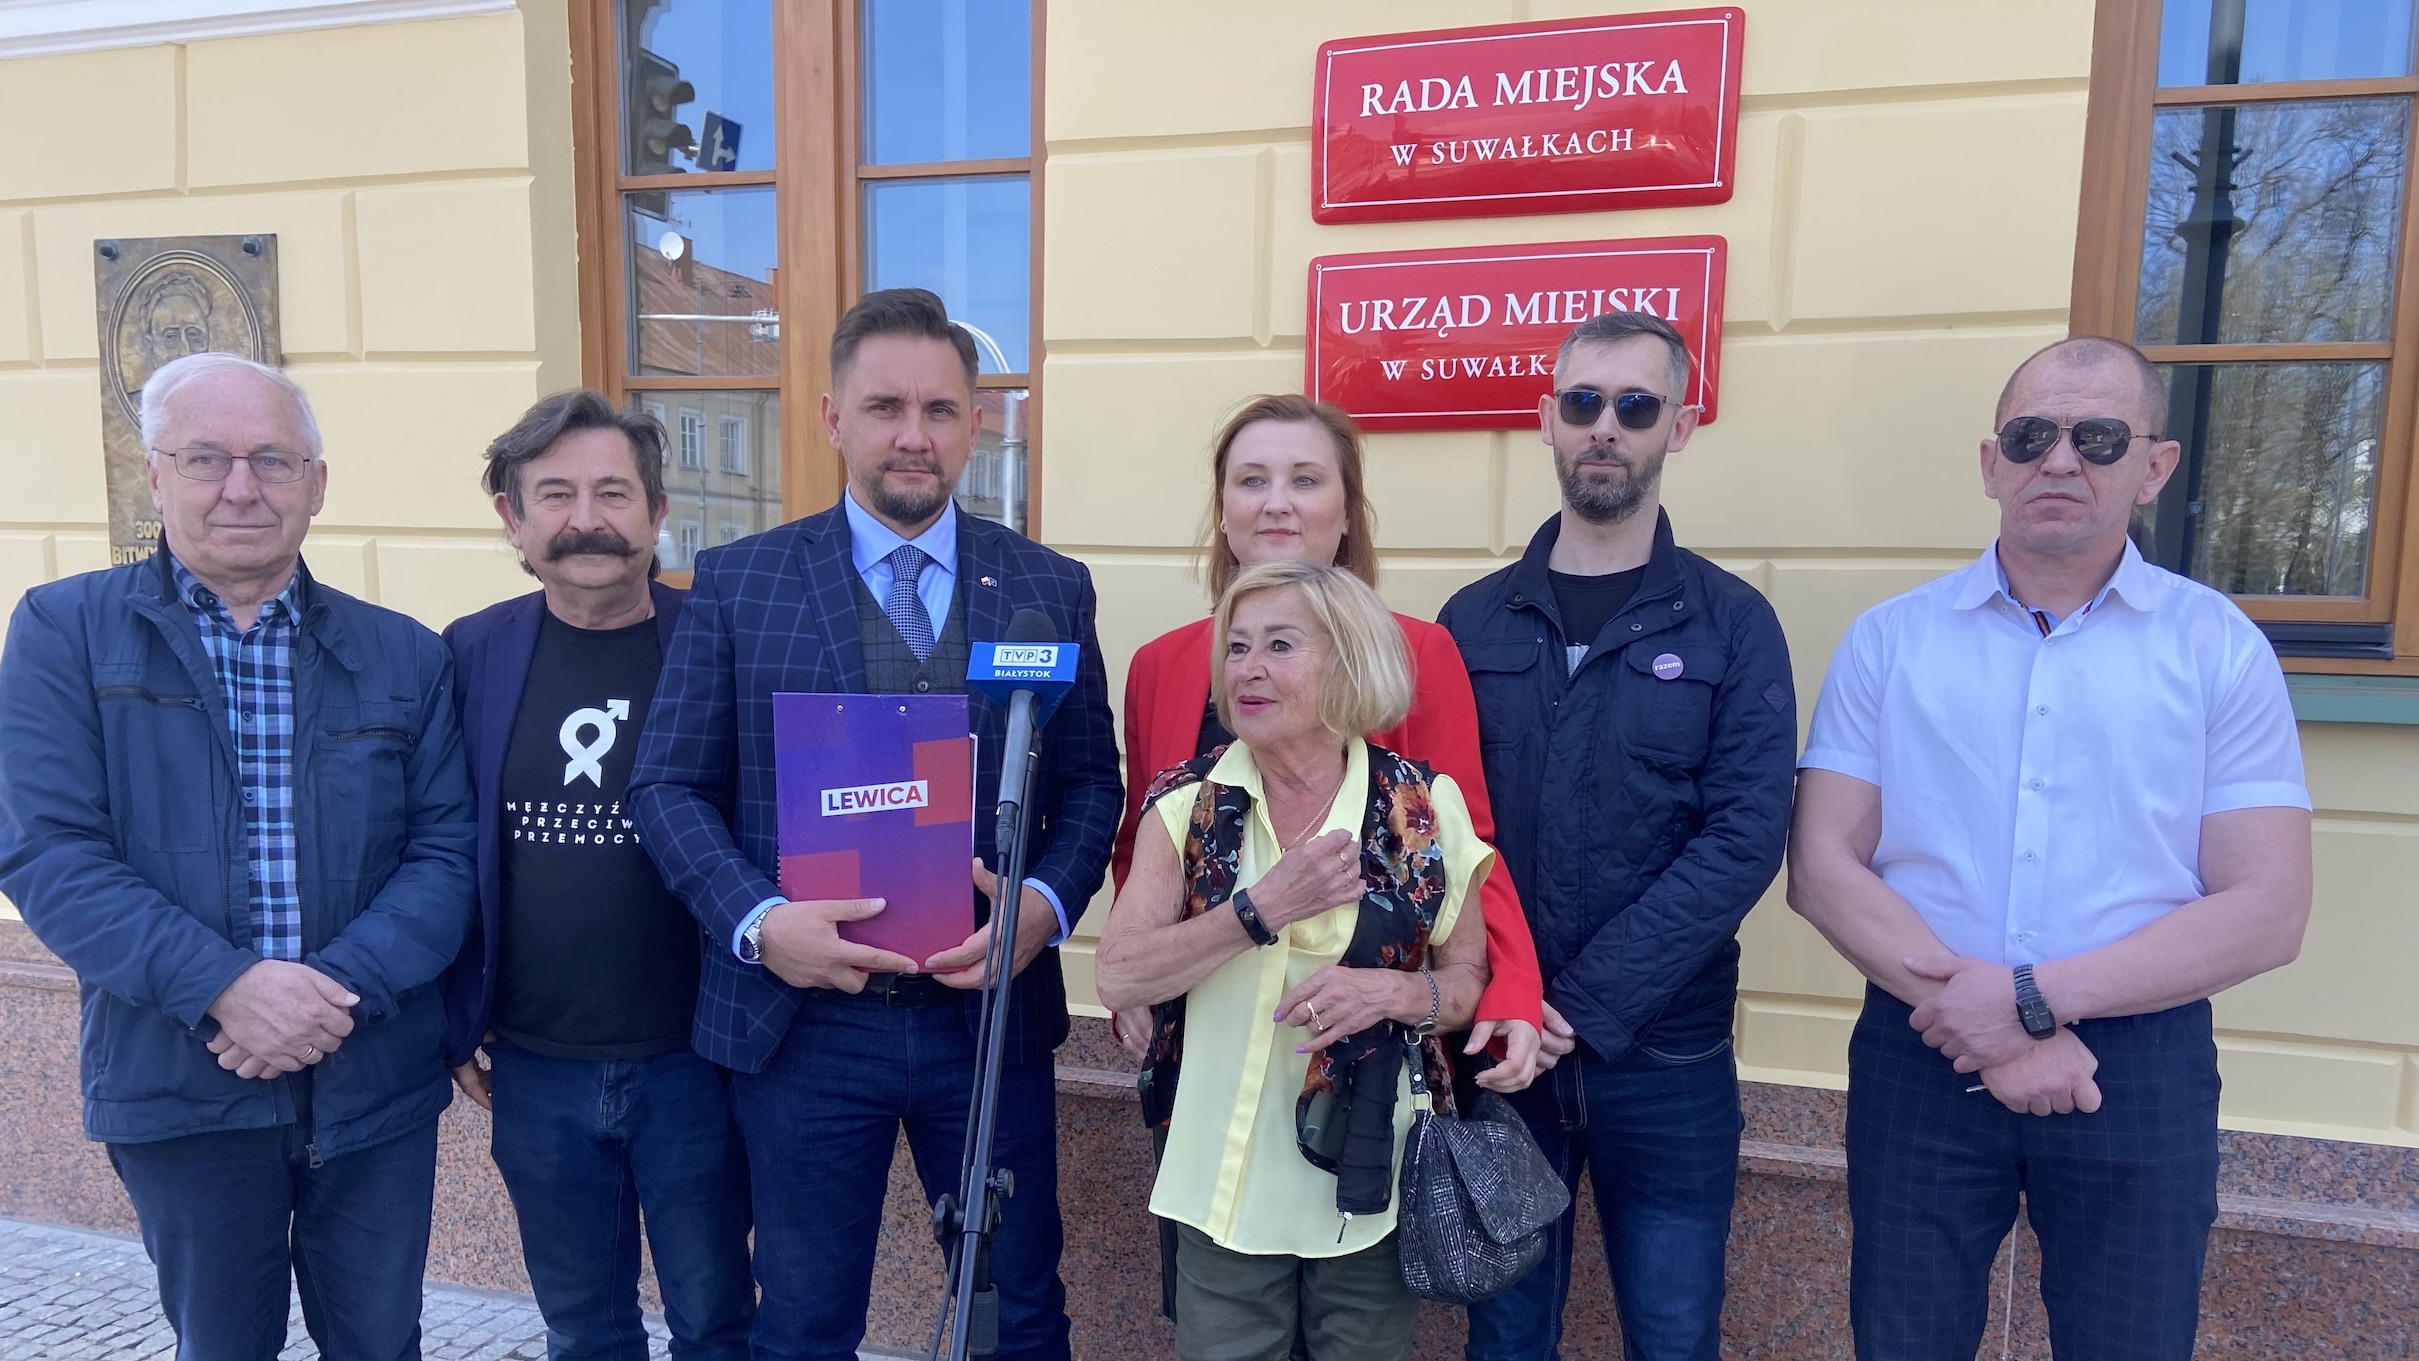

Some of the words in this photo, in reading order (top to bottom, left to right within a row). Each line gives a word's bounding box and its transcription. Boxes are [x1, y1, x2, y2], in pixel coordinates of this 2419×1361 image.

[1359, 74, 1479, 118] RADA
[1493, 59, 1688, 111] MIEJSKA
[1390, 144, 1418, 166] W
[1432, 128, 1634, 165] SUWAŁKACH
[1339, 294, 1491, 338] URZĄD
[1381, 360, 1408, 381] W
[1421, 354, 1554, 381] SUWAŁK
[135, 521, 161, 539] 300
[995, 669, 1051, 678] BIAŁYSTOK
[1655, 661, 1681, 671] razem
[828, 785, 922, 811] LEWICA
[521, 816, 633, 829] PRZECIW
[514, 829, 641, 845] PRZEMOCY
